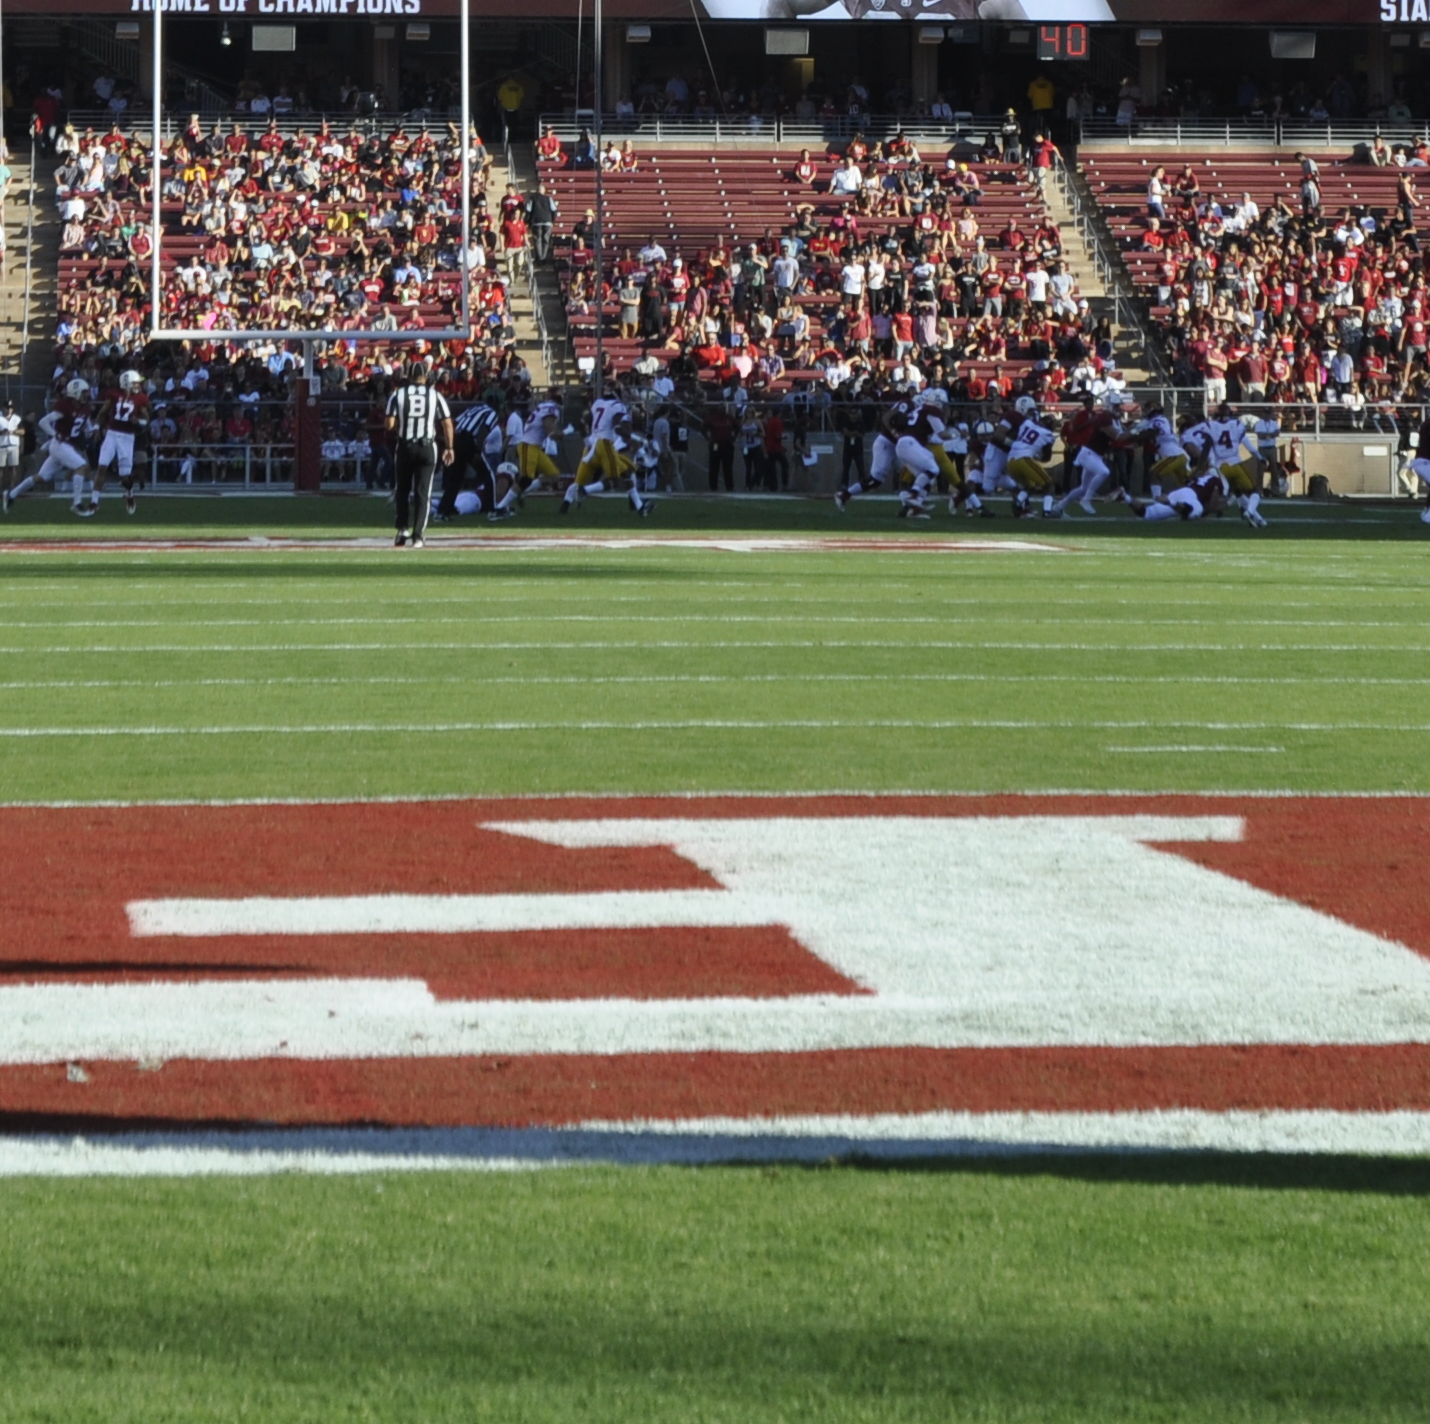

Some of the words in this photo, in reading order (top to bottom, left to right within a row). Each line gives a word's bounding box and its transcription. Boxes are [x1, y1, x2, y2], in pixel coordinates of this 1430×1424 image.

[1039, 23, 1088, 56] 40
[113, 402, 135, 423] 17
[407, 394, 427, 418] B
[70, 418, 85, 439] 2
[592, 406, 606, 430] 7
[1019, 424, 1041, 446] 19
[1217, 429, 1235, 451] 4
